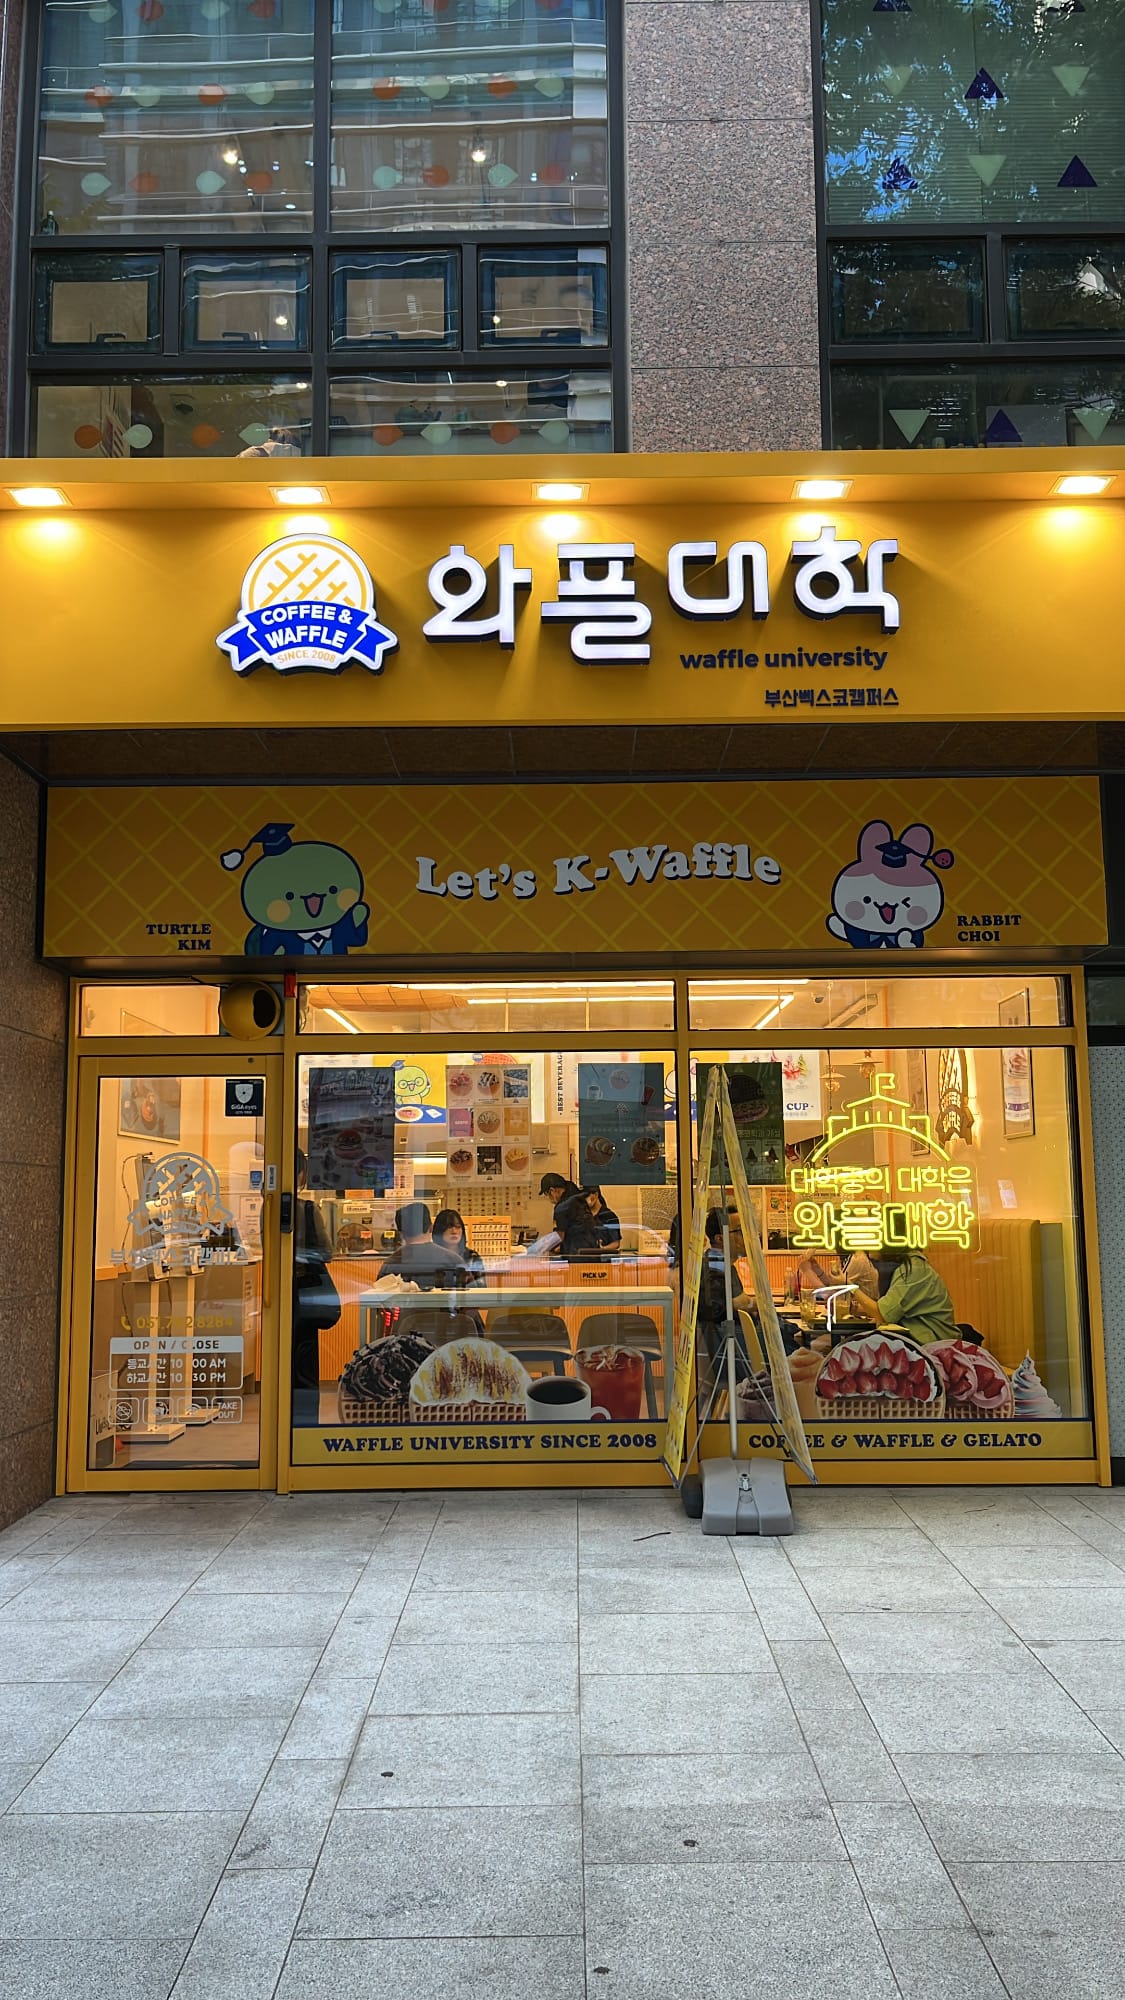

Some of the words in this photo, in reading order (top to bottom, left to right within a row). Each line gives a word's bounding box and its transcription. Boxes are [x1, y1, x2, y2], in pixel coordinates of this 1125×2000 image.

[422, 526, 900, 662] 와플대학
[260, 604, 336, 626] COFFEE
[340, 609, 353, 625] &
[265, 626, 348, 650] WAFFLE
[277, 651, 308, 664] SINCE
[311, 649, 337, 663] 2008
[680, 649, 759, 669] waffle
[765, 646, 888, 671] university
[764, 687, 900, 708] 부산벡스코캠퍼스
[553, 841, 782, 896] K-Waffle
[957, 914, 1022, 927] RABBIT
[145, 923, 212, 936] TURTLE
[957, 930, 1001, 942] CHOI
[177, 939, 212, 951] KIM
[786, 1102, 809, 1111] CUP
[897, 1165, 973, 1194] 대학은
[792, 1199, 976, 1250] 와플대학
[133, 1341, 167, 1351] OPN
[209, 1358, 227, 1368] AM
[209, 1372, 227, 1383] PM
[217, 1402, 238, 1410] TAKE
[218, 1411, 235, 1419] OUT
[323, 1437, 403, 1452] WAFFLE
[410, 1435, 535, 1450] UNIVERSITY
[540, 1434, 602, 1448] SINCE
[607, 1434, 657, 1448] 2008
[748, 1434, 825, 1449] COFEE
[831, 1434, 848, 1448] &
[853, 1434, 935, 1448] WAFFLE
[940, 1433, 957, 1447] &
[963, 1433, 1043, 1448] GELATO
